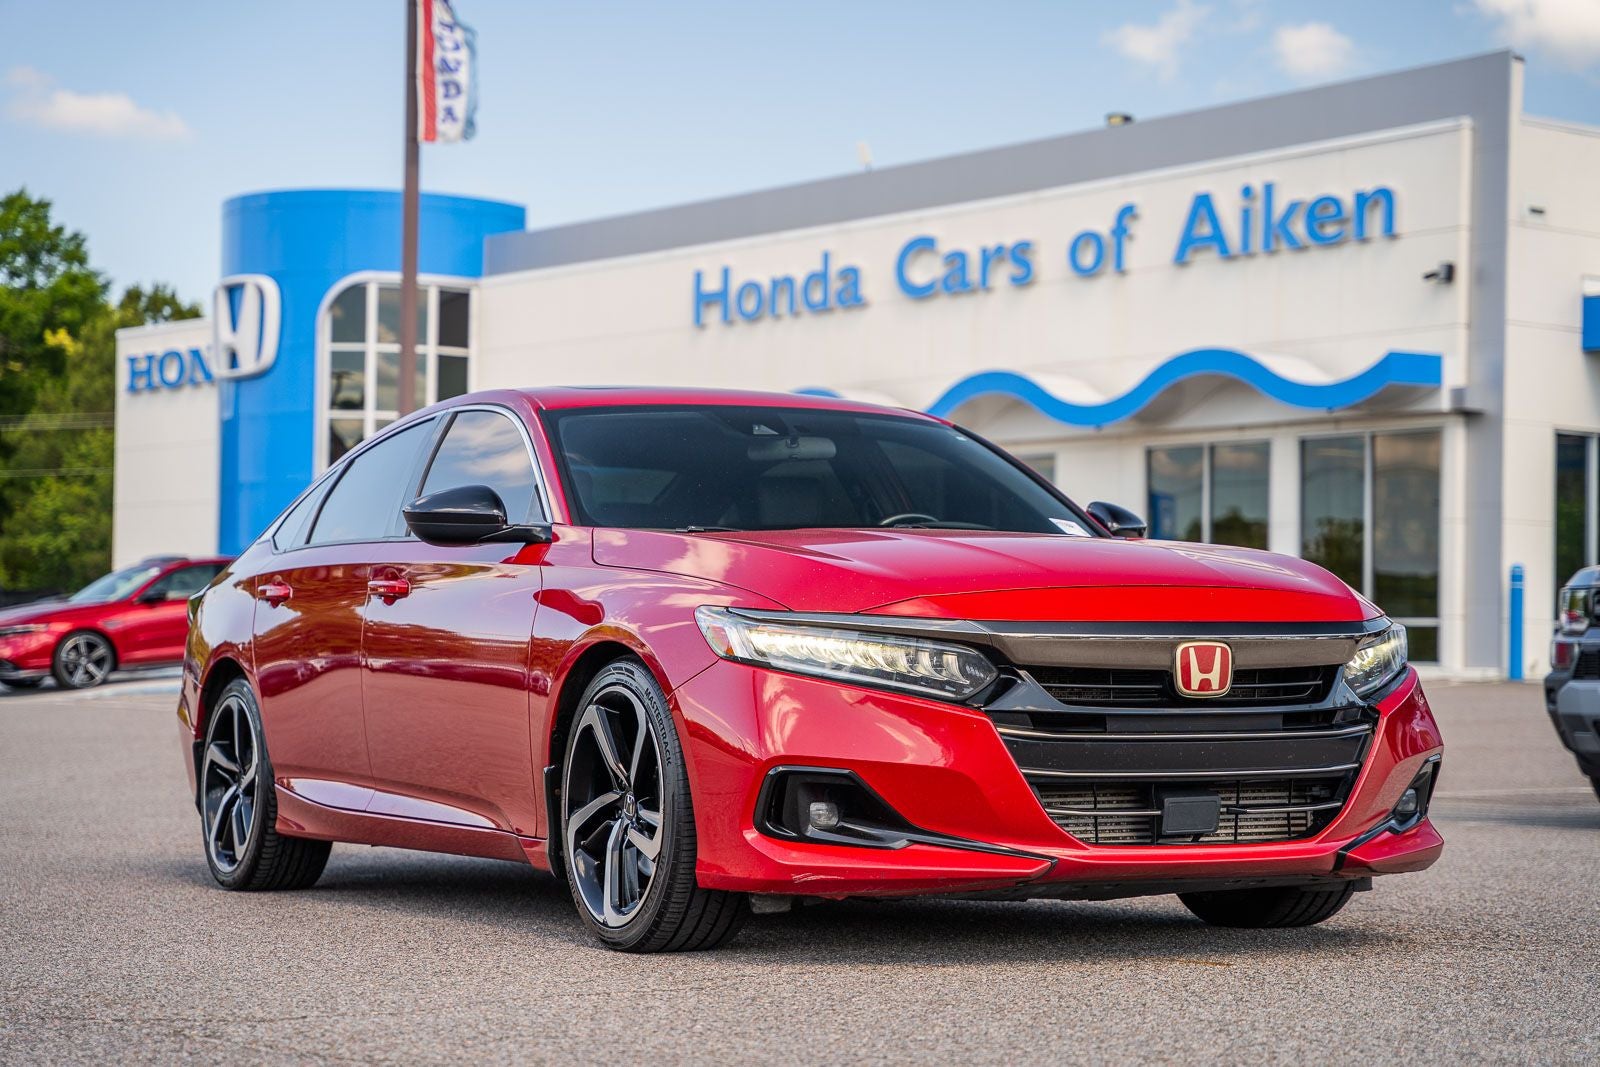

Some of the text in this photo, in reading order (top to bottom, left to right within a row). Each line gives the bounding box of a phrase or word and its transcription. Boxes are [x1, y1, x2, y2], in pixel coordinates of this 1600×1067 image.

[693, 183, 1396, 327] Honda Cars of Aiken
[643, 687, 672, 767] MASTERTRACK
